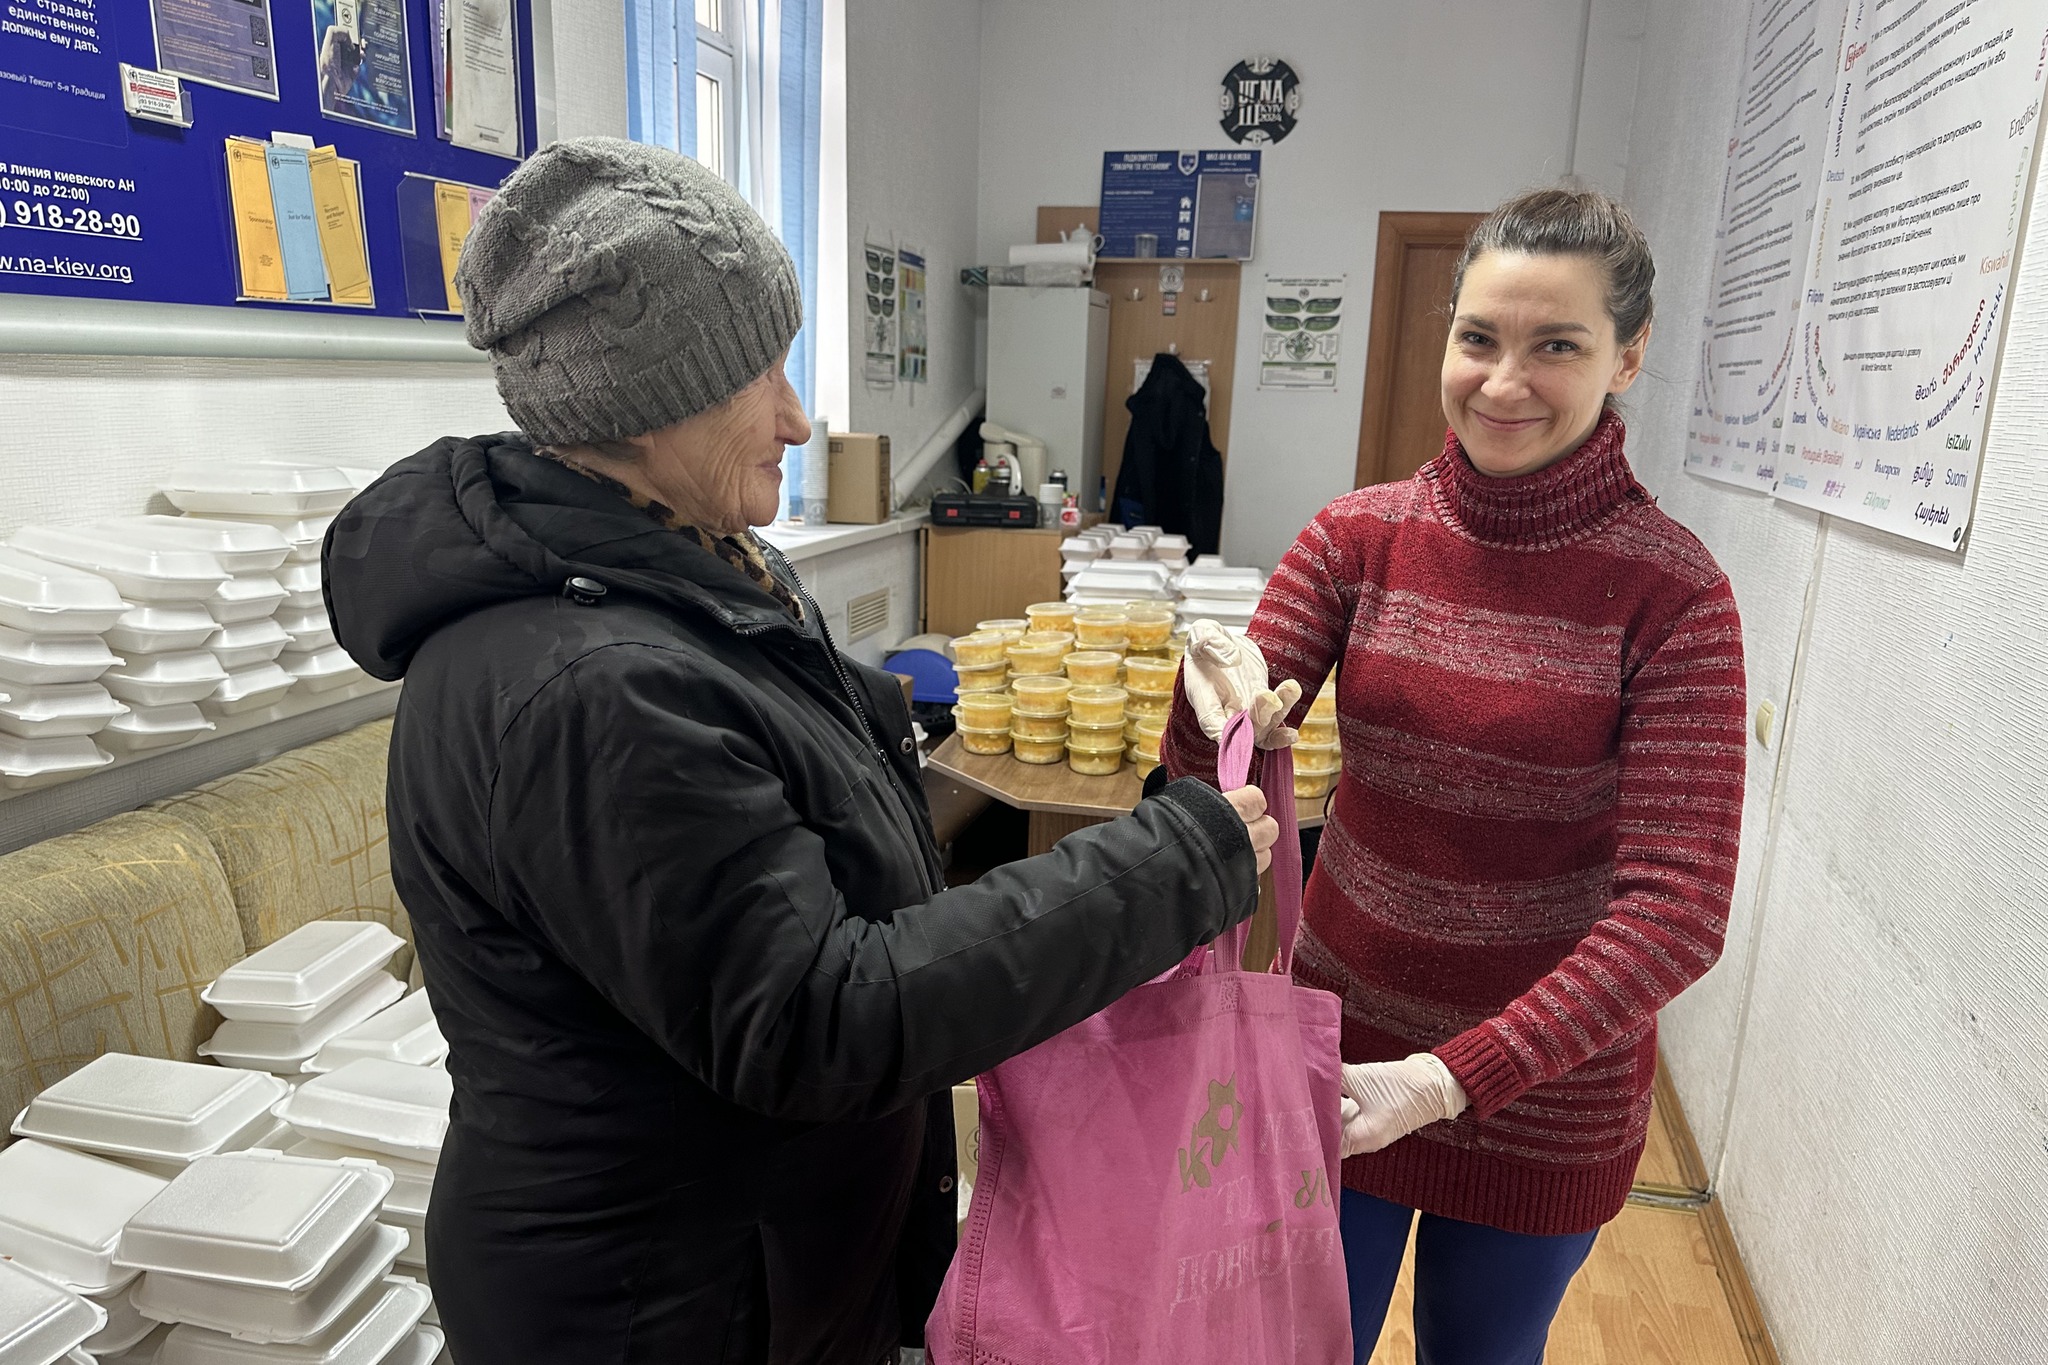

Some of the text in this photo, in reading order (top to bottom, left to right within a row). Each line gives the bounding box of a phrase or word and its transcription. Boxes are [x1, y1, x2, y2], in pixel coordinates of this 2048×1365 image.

[37, 0, 98, 25] страдает,
[1943, 0, 1967, 21] завдали
[8, 5, 100, 41] единственное,
[1953, 15, 1970, 35] усіма.
[1, 20, 102, 55] должны ему дать.
[1942, 54, 1966, 72] кожному
[1970, 44, 1983, 58] цих
[1982, 30, 2003, 51] людей,
[2003, 27, 2013, 41] де
[1252, 57, 1270, 72] 12
[1938, 77, 1954, 91] могло
[1954, 61, 1987, 82] нашкодити
[1986, 55, 1994, 68] їм
[1993, 48, 2006, 64] або
[57, 82, 70, 92] 5-я
[70, 84, 106, 100] Традиция
[1289, 94, 1299, 110] 3
[1221, 95, 1230, 112] 9
[1834, 82, 1851, 157] Malayalam
[2008, 98, 2038, 139] English
[1252, 131, 1263, 147] 6
[1884, 154, 1904, 169] особисту
[1936, 135, 1943, 145] та
[1942, 120, 1982, 143] допускаючись
[10, 164, 52, 180] линия
[54, 171, 116, 190] киевского
[118, 178, 136, 193] АН
[1825, 168, 1845, 182] Deutsch
[33, 184, 50, 197] до
[52, 184, 90, 204] 22:00)
[1889, 205, 1895, 213] та
[1895, 197, 1920, 211] медитацію
[1920, 186, 1950, 203] покращення
[1949, 179, 1969, 193] нашого
[13, 200, 141, 237] 918-28-90
[1896, 215, 1909, 227] Його
[1908, 209, 1931, 226] розуміли,
[1931, 202, 1955, 216] молячись
[1956, 197, 1970, 208] лише
[1970, 193, 1981, 205] про
[1904, 227, 1932, 242] здійснення.
[1900, 267, 1907, 275] як
[1906, 261, 1931, 276] результат
[1929, 260, 1940, 270] цих
[1939, 254, 1957, 268] кроків,
[1957, 253, 1966, 262] ми
[1979, 248, 2010, 274] Kiswahili
[1885, 284, 1906, 295] залежних
[1906, 282, 1912, 291] та
[1911, 276, 1946, 290] застосовувати
[1945, 272, 1953, 285] ці
[1806, 288, 1824, 306] Filipino
[1973, 283, 2003, 364] Hrvatski
[1942, 299, 1985, 387] ქართული
[1914, 377, 1937, 400] తెలుగు
[1972, 376, 1984, 415] ASL
[1791, 411, 1806, 424] Dansk
[1816, 405, 1828, 427] Czech
[1852, 424, 1881, 440] Українська
[1885, 421, 1919, 441] Nederlands
[1945, 433, 1971, 451] isiZulu
[1911, 461, 1934, 488] தமிழ்
[1944, 468, 1968, 487] Suomi
[1914, 501, 1949, 526] Հայերեն
